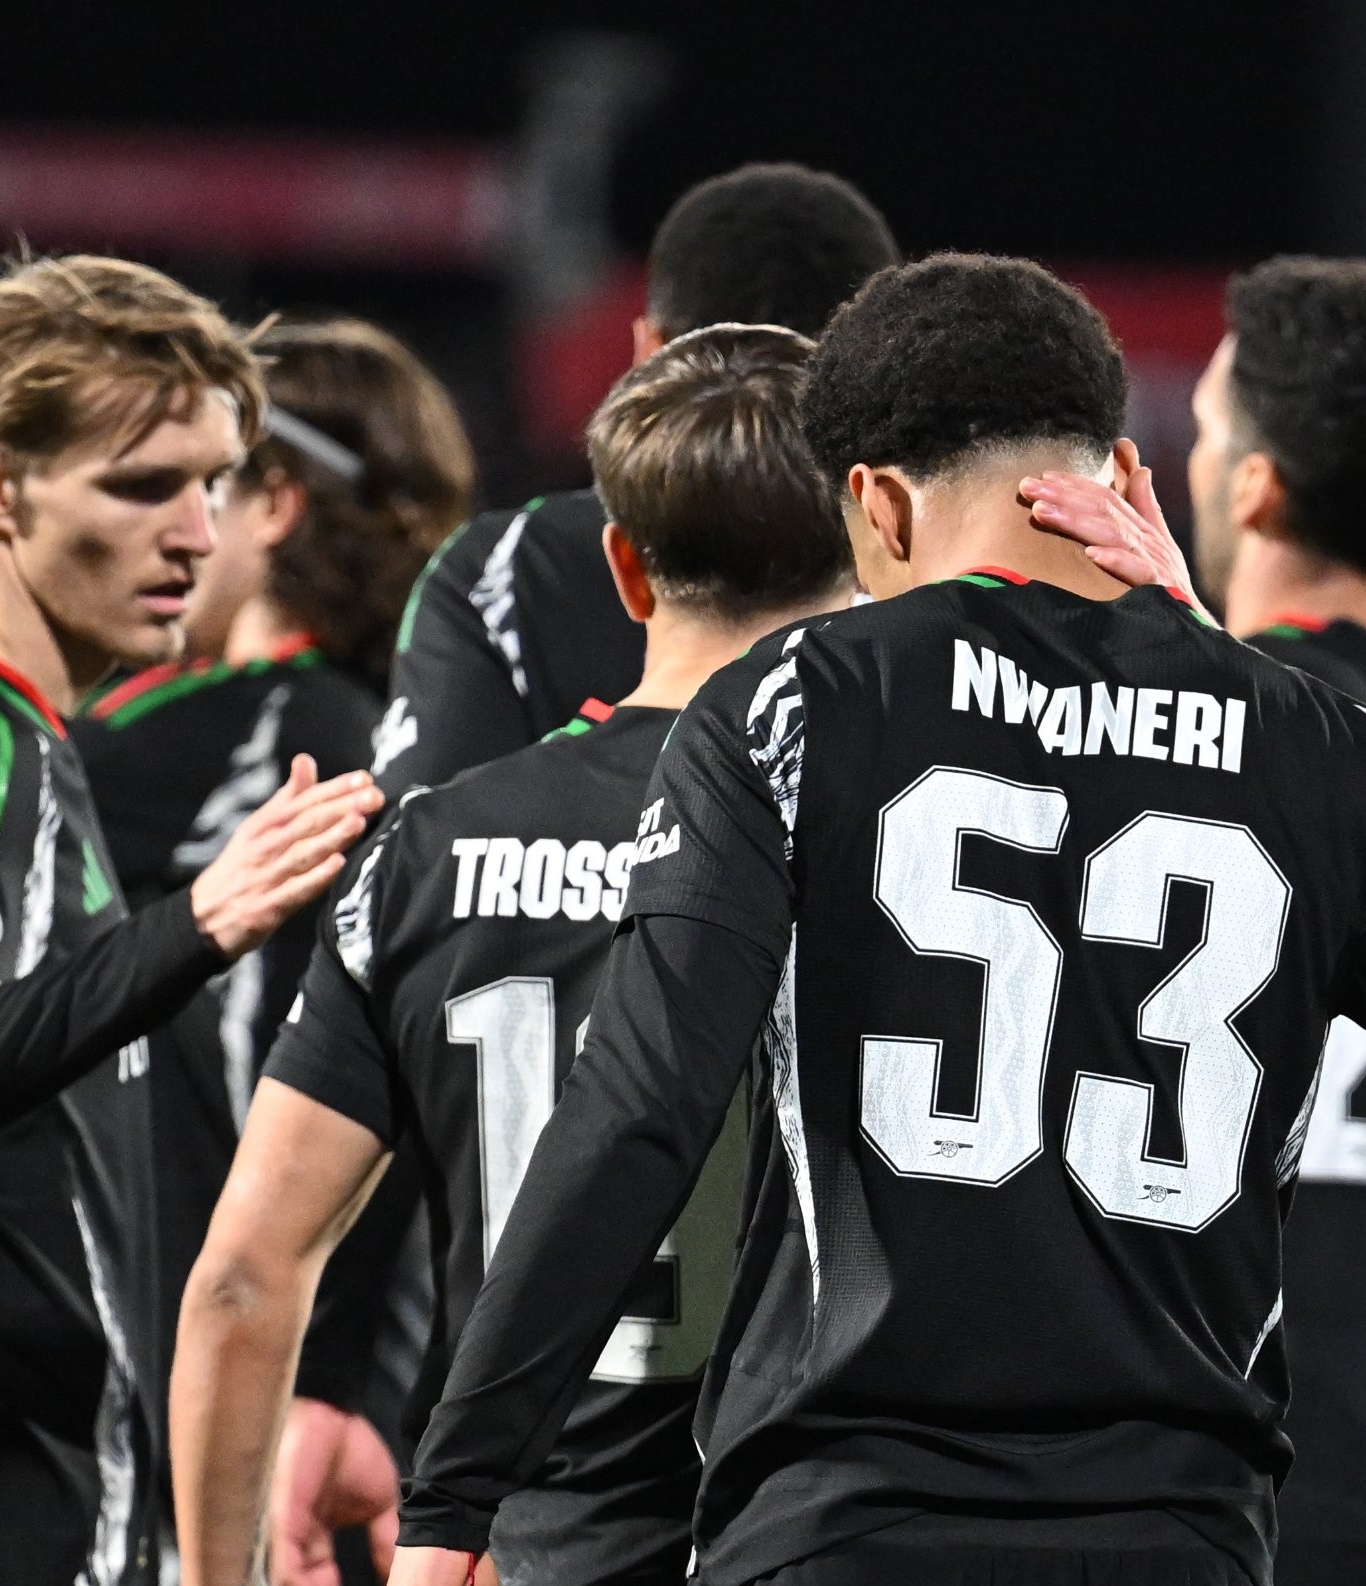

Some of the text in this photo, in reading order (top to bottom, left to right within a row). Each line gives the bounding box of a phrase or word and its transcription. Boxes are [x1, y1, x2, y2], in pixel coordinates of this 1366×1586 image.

[951, 638, 1247, 774] NWANERI
[451, 837, 636, 922] TROSS
[859, 765, 1294, 1235] 53
